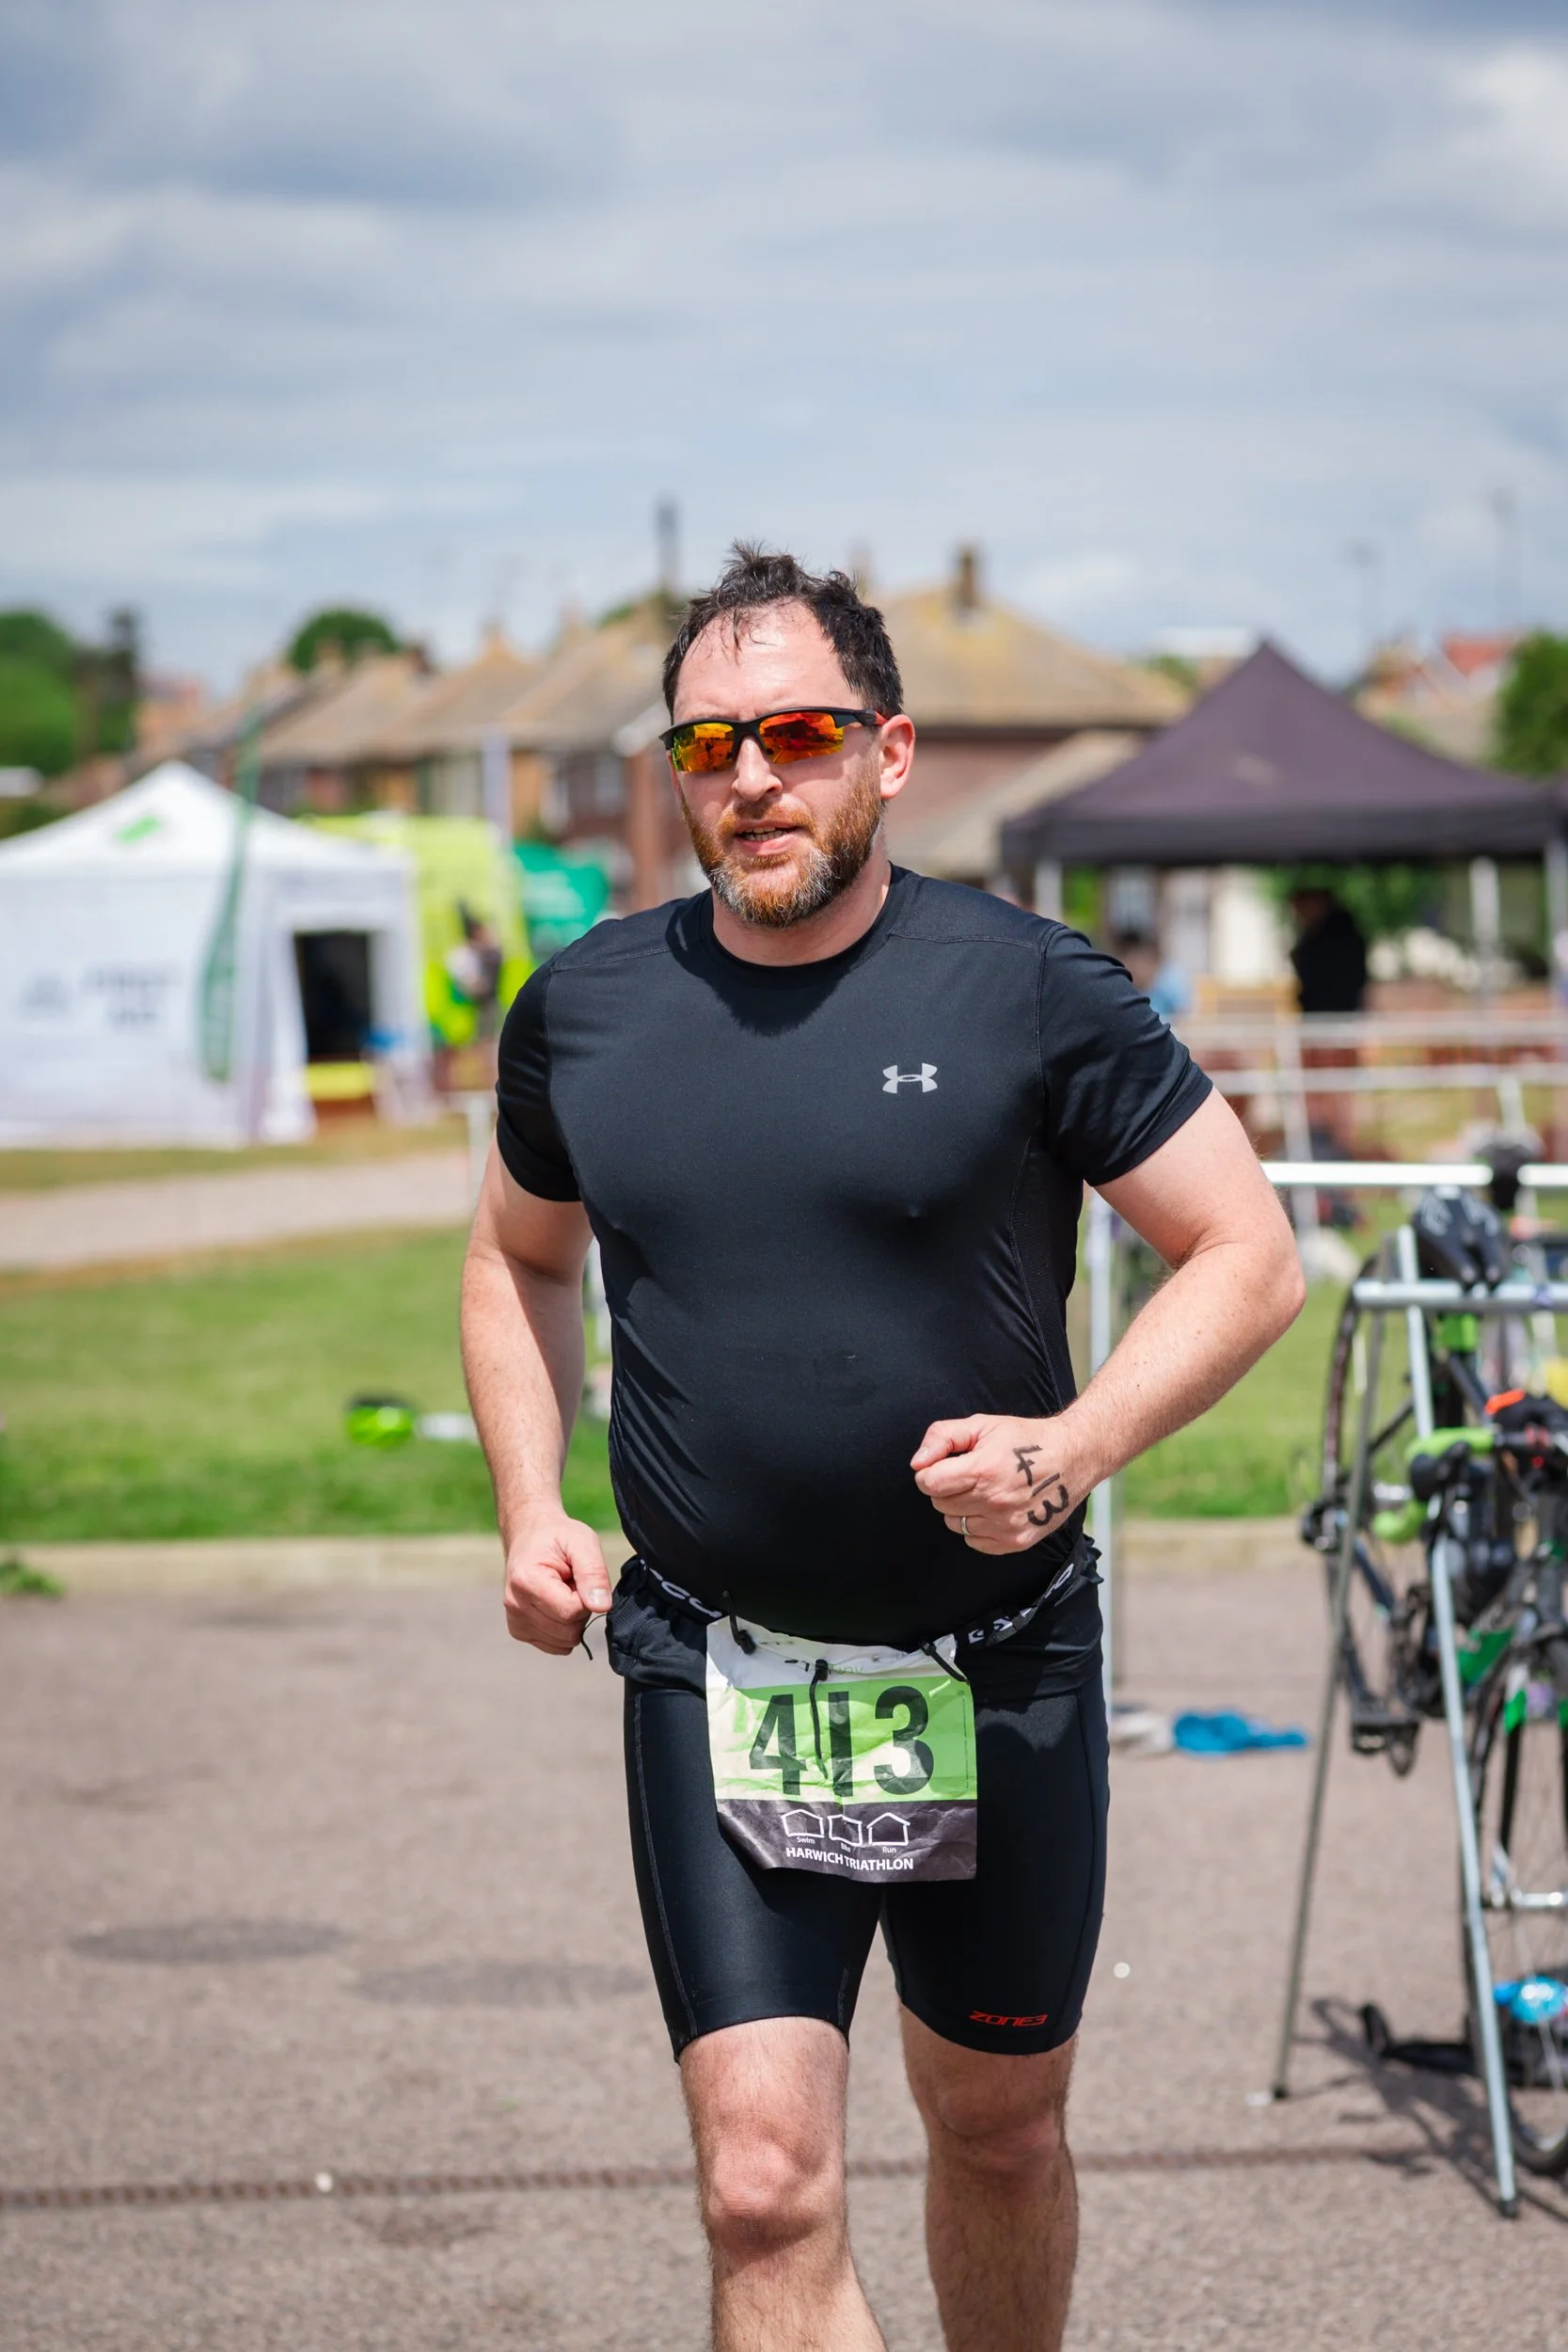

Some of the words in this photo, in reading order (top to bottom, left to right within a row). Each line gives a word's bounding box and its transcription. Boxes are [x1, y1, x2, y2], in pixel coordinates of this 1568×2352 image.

[1012, 1444, 1069, 1526] 413
[749, 1685, 934, 1798] 413
[785, 1847, 843, 1865] HARWICH
[846, 1856, 914, 1870] TRIATHLON
[796, 1836, 816, 1845] Swim
